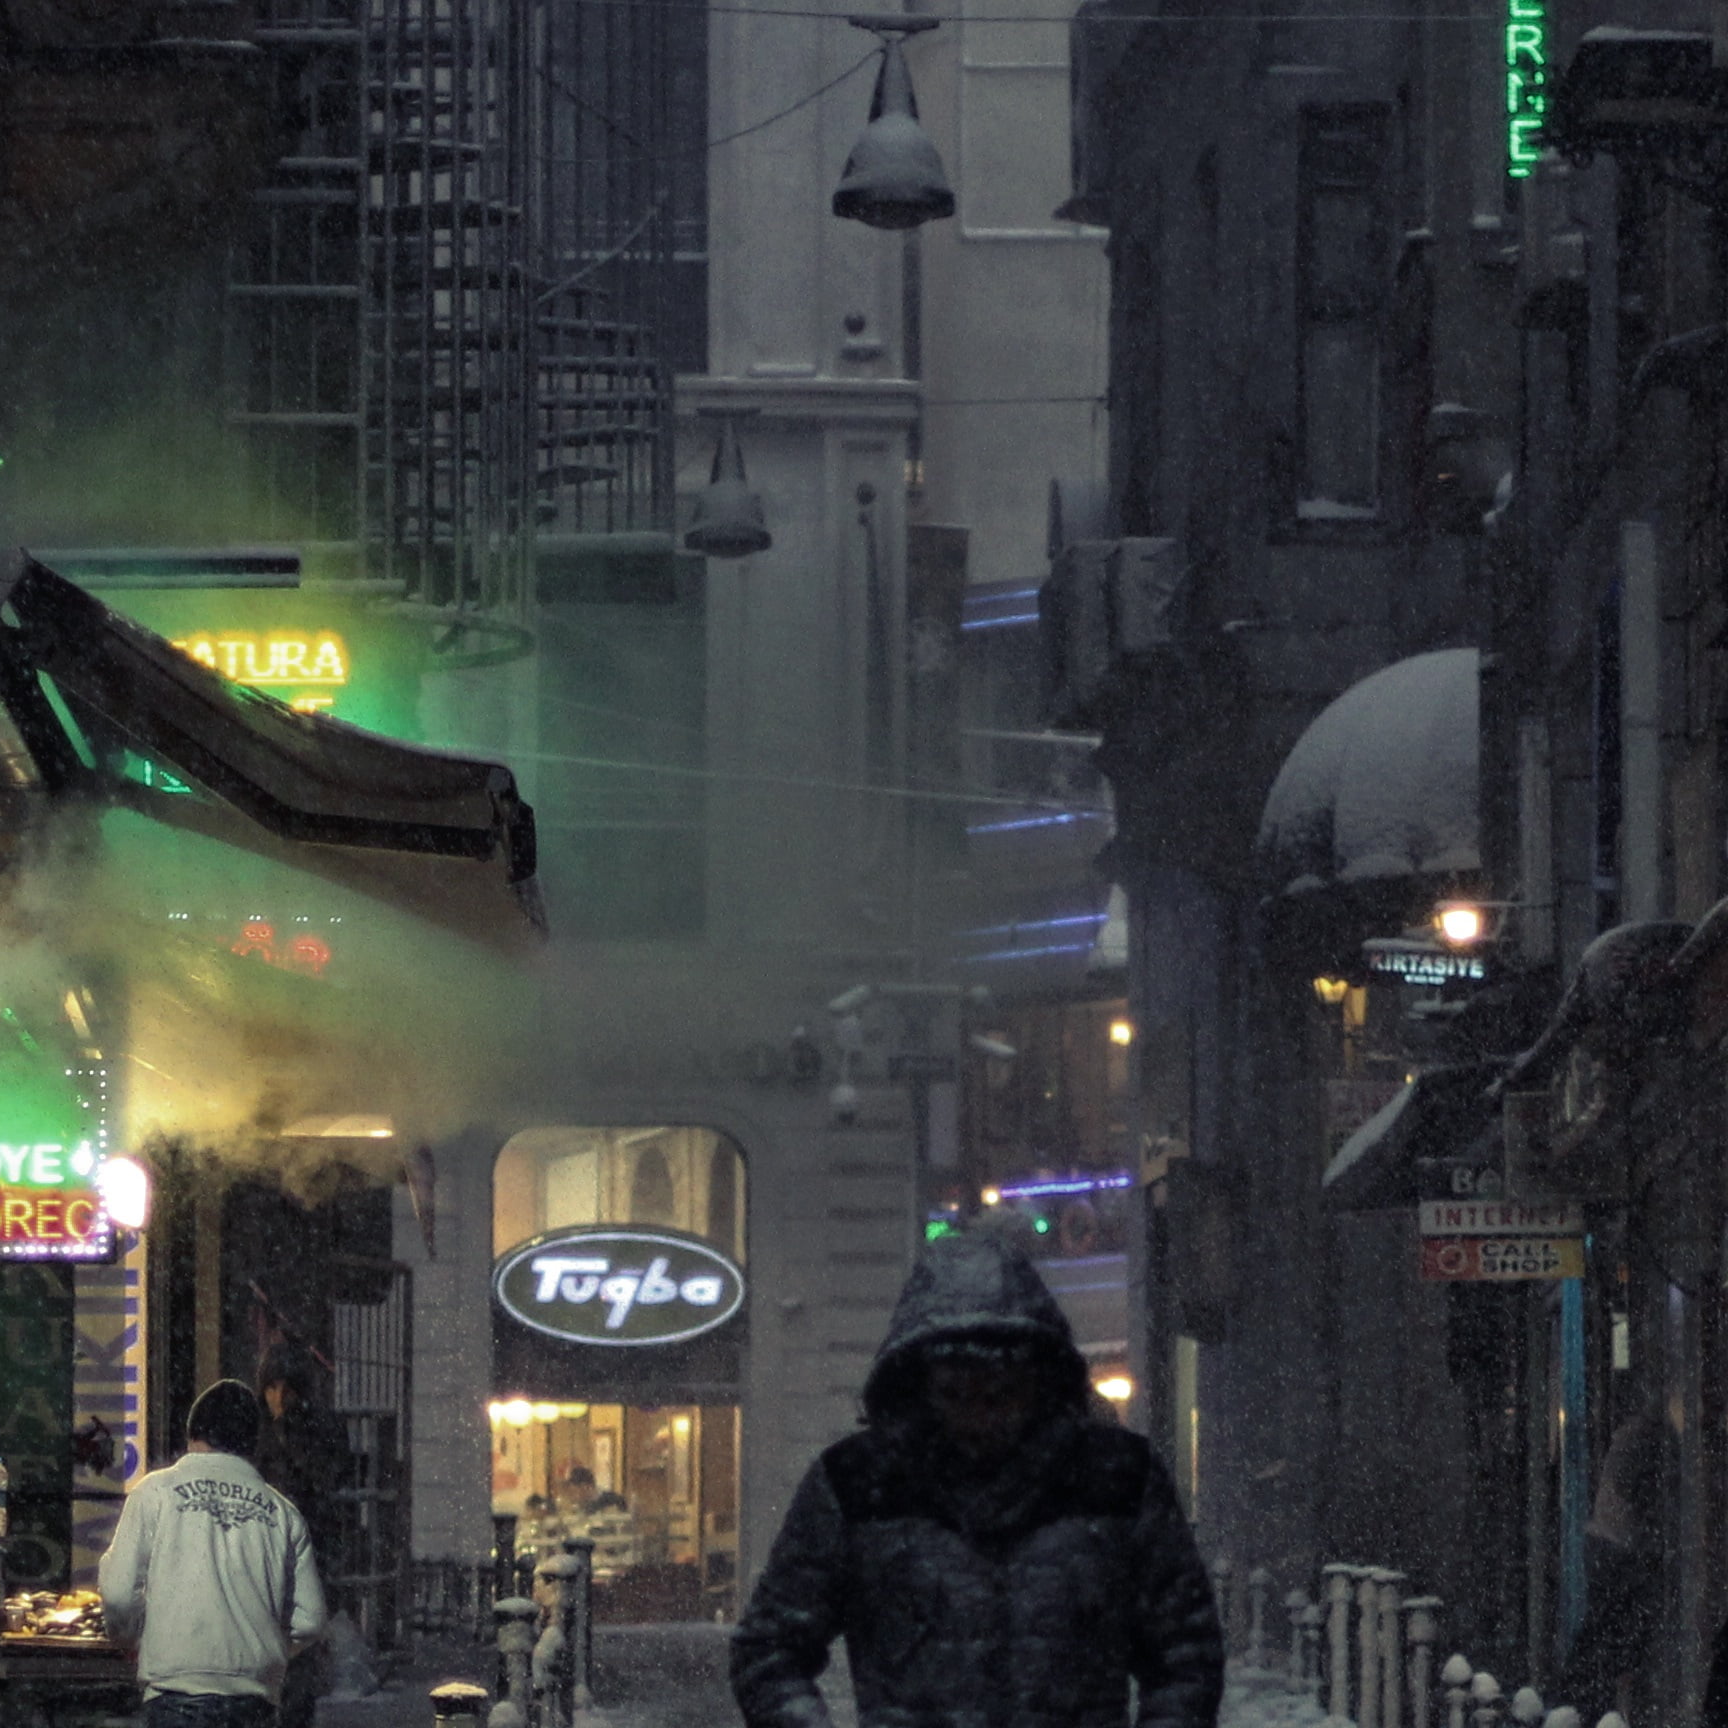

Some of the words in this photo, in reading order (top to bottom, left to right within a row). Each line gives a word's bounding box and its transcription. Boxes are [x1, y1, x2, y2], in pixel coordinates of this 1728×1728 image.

[1481, 1243, 1552, 1257] CALL
[1482, 1259, 1559, 1273] SHOP
[174, 1479, 278, 1515] VICTORIAN
